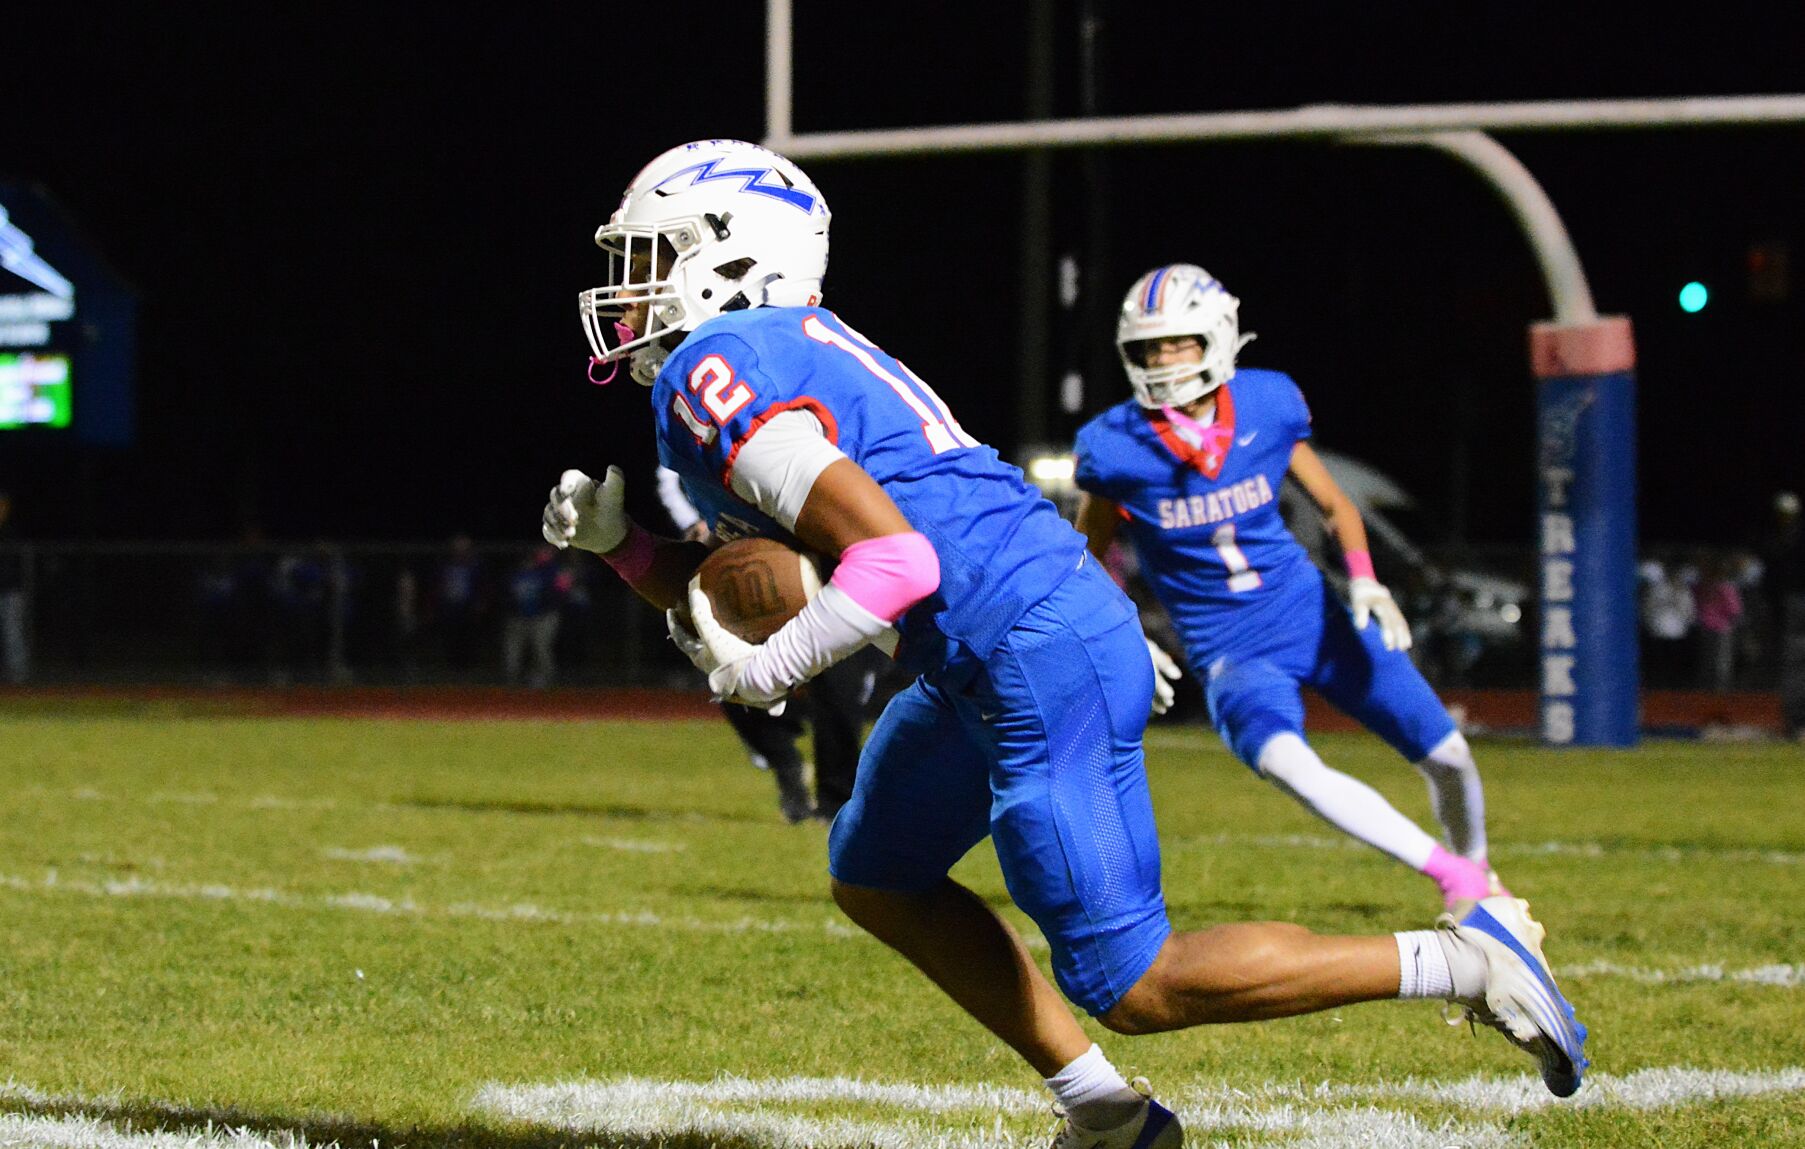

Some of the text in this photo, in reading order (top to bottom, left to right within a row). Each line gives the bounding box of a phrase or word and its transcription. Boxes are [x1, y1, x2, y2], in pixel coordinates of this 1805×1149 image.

[673, 354, 756, 446] 12
[1158, 473, 1273, 530] SARATOGA
[1210, 522, 1263, 593] 1
[1541, 424, 1577, 744] TREAKS
